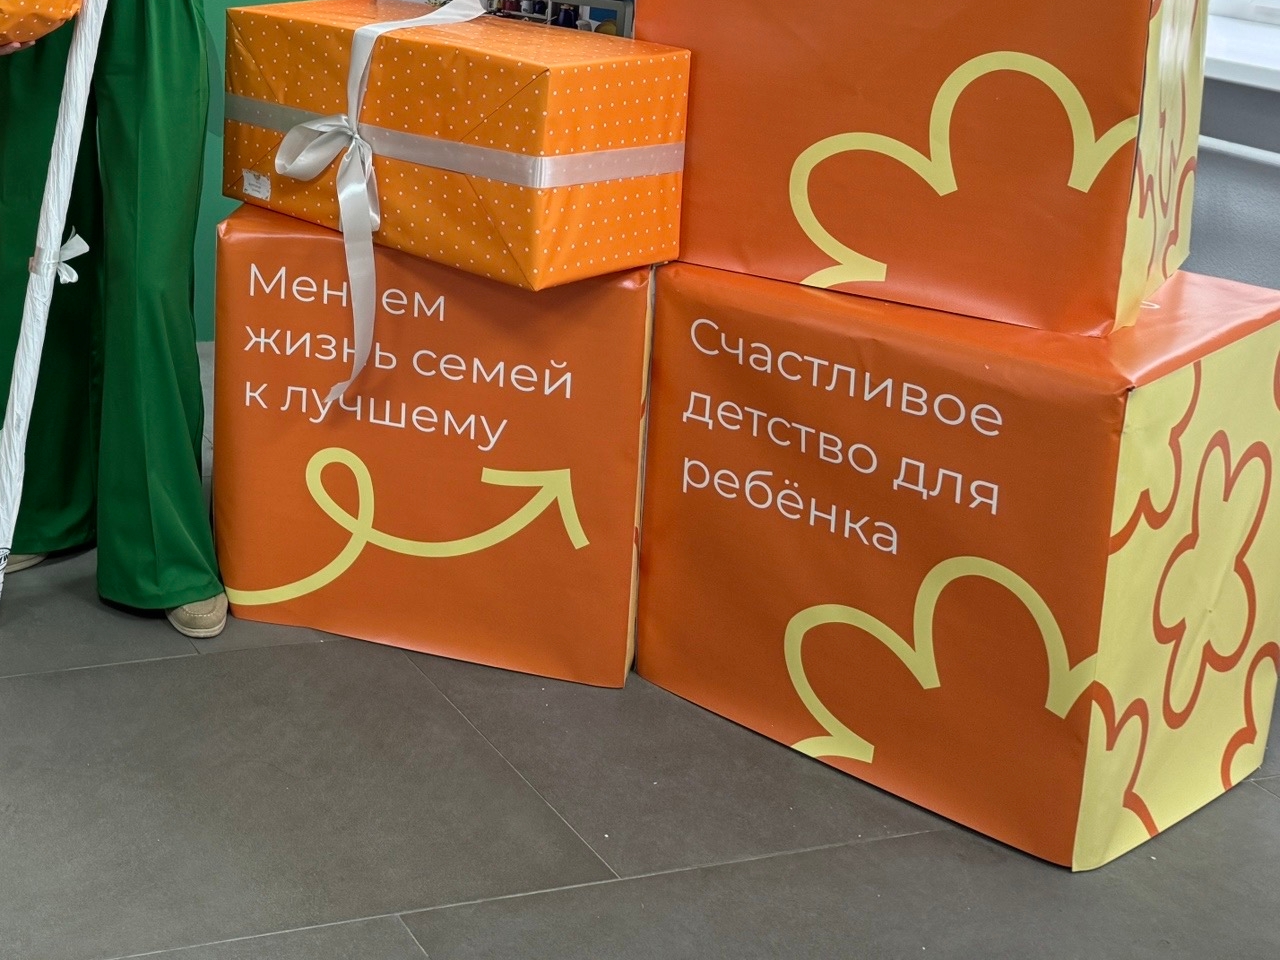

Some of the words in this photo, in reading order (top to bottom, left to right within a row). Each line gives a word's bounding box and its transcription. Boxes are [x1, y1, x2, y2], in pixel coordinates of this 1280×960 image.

[249, 263, 445, 322] Менем
[411, 349, 573, 399] семей
[690, 318, 1004, 437] Счастливое
[245, 381, 269, 410] к
[280, 385, 509, 453] лучшему
[682, 391, 878, 475] детство
[893, 457, 1000, 516] для
[682, 457, 898, 556] ребёнка
